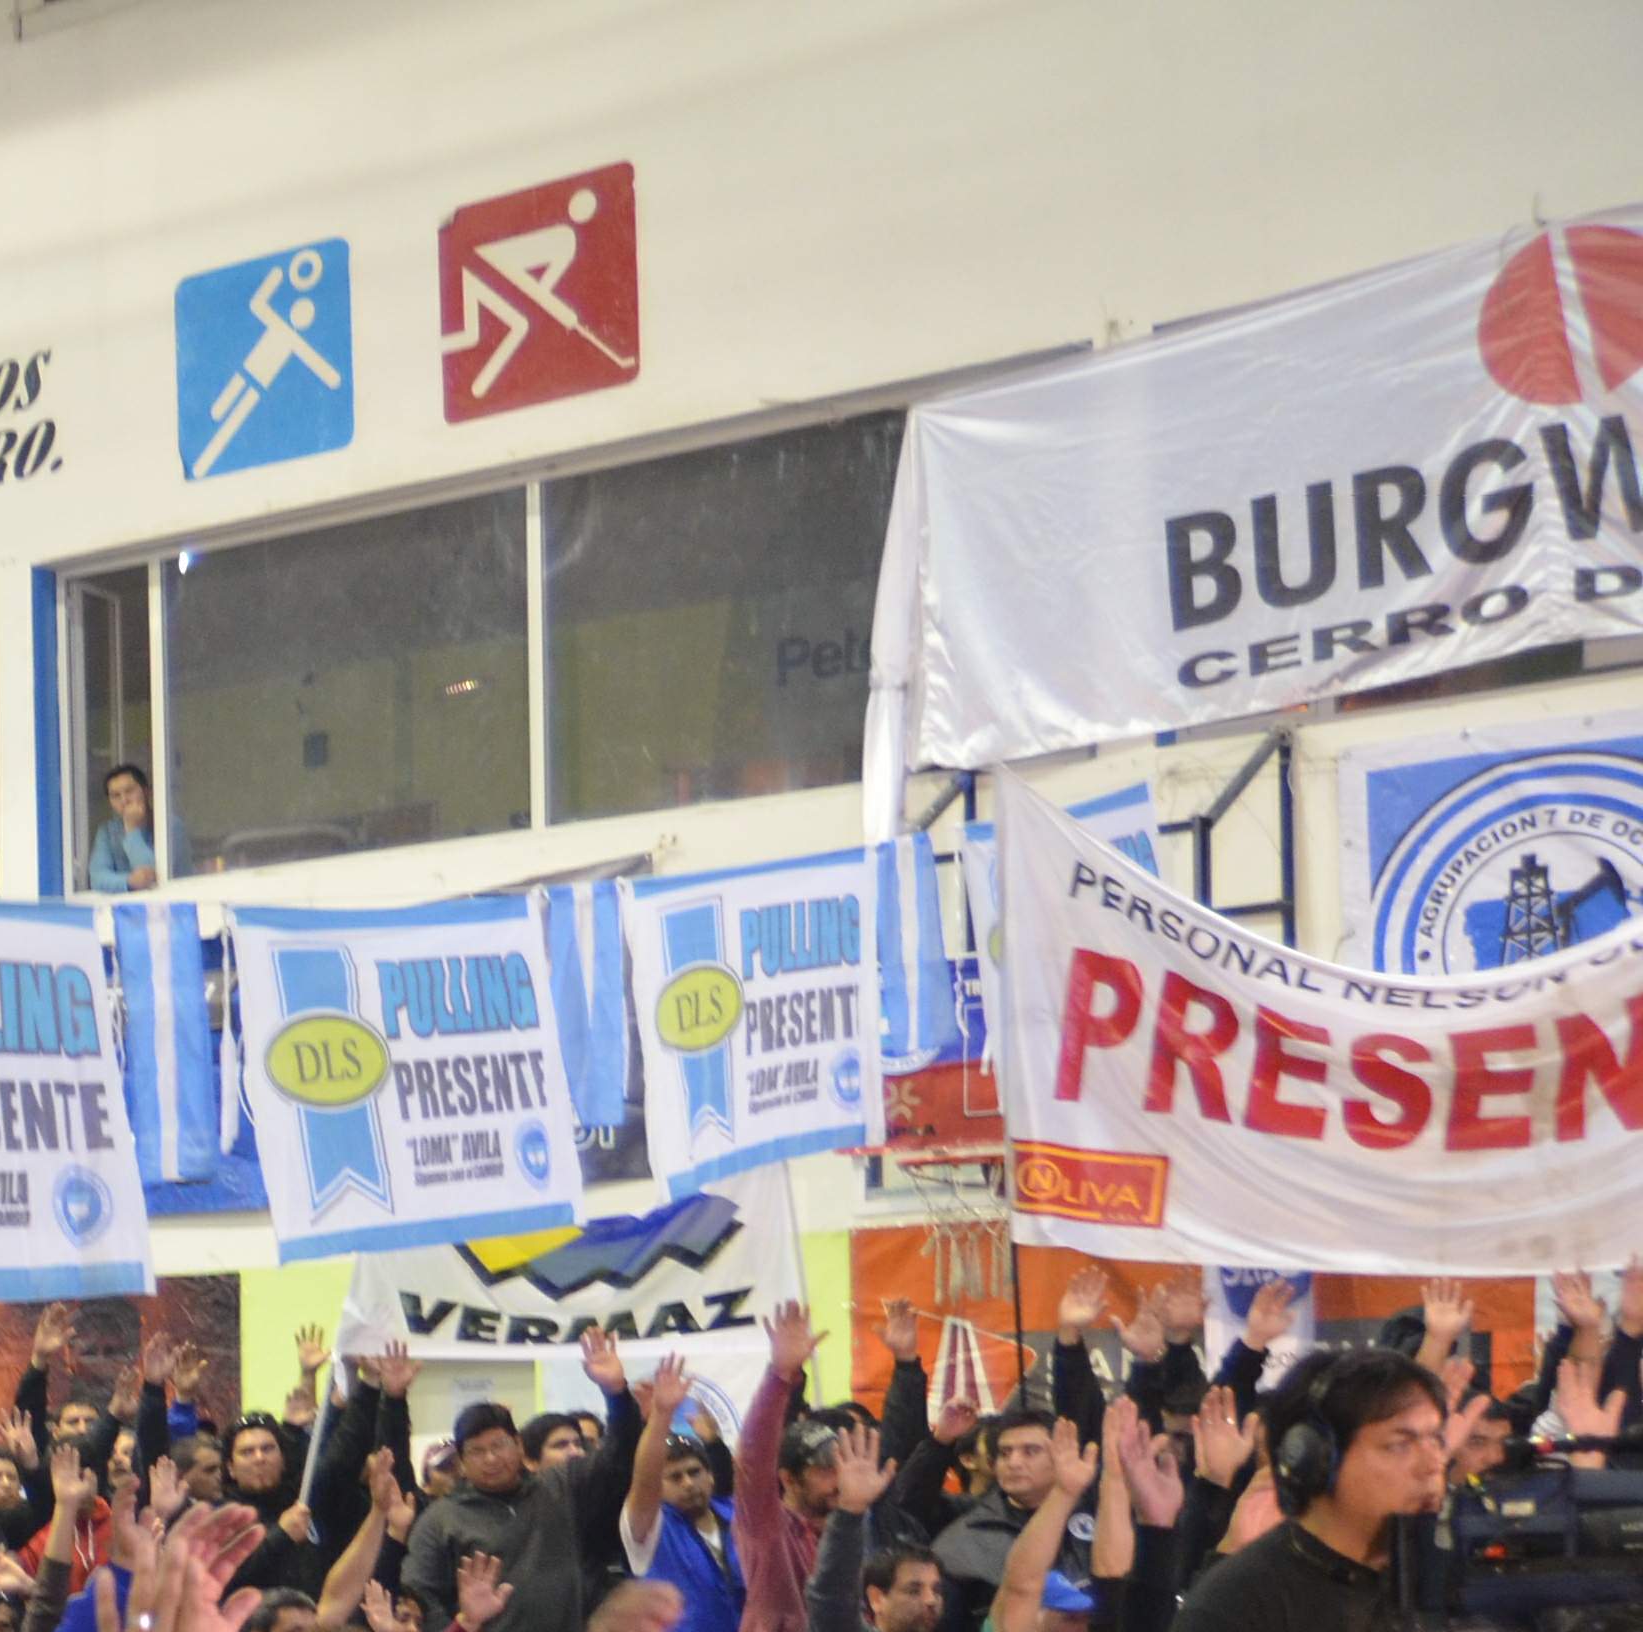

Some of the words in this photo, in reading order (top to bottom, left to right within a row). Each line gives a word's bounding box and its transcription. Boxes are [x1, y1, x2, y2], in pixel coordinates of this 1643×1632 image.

[1178, 585, 1530, 689] CERRO
[1419, 813, 1538, 939] AGRUPACION
[1545, 809, 1557, 825] 7
[1568, 808, 1605, 829] DE
[740, 893, 860, 981] PULLING
[1070, 861, 1323, 993] PERSONAL
[375, 951, 540, 1040] PULLING
[294, 1038, 362, 1084] DLS
[1055, 947, 1643, 1151] PRESEN
[400, 1287, 756, 1345] VERMAZ
